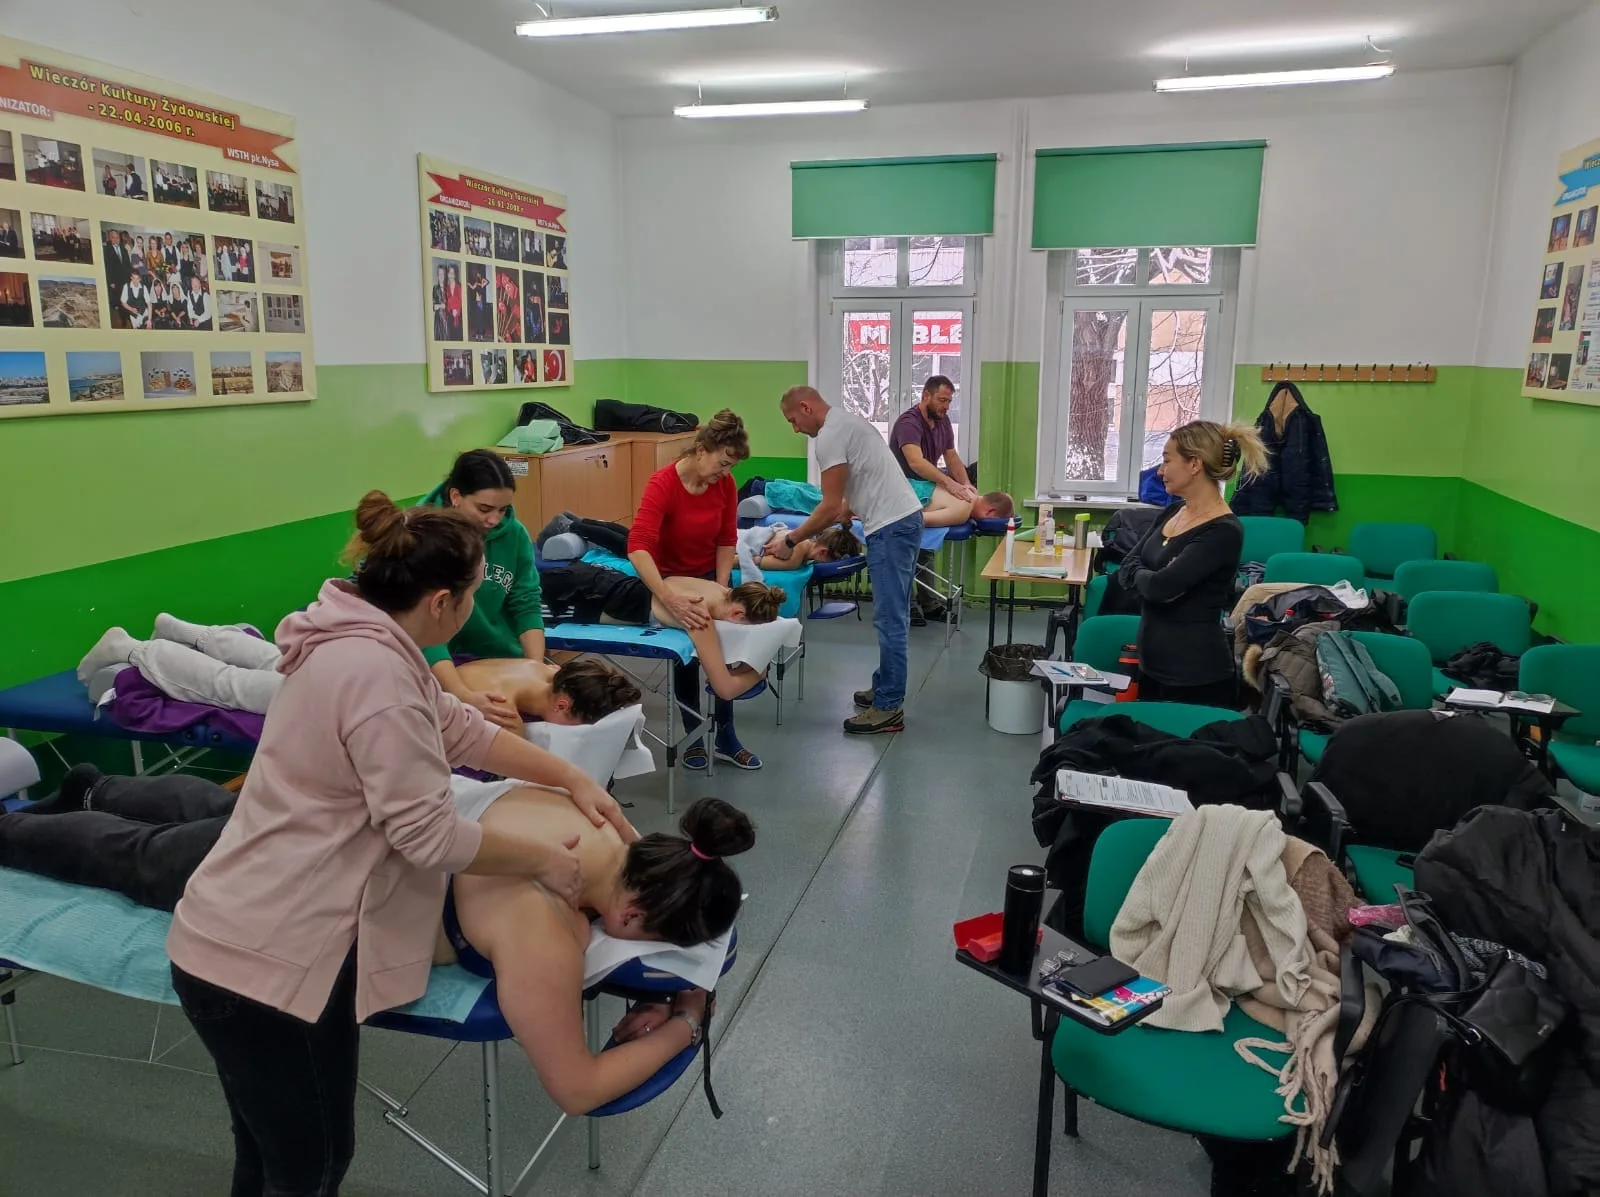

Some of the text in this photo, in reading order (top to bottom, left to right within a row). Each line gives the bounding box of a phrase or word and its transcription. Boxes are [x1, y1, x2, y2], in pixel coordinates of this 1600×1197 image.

[29, 63, 236, 131] Wieczór Kultury Żydowskiej
[99, 103, 182, 134] 22.04.2006
[185, 125, 196, 137] r.
[860, 324, 962, 346] MBLE
